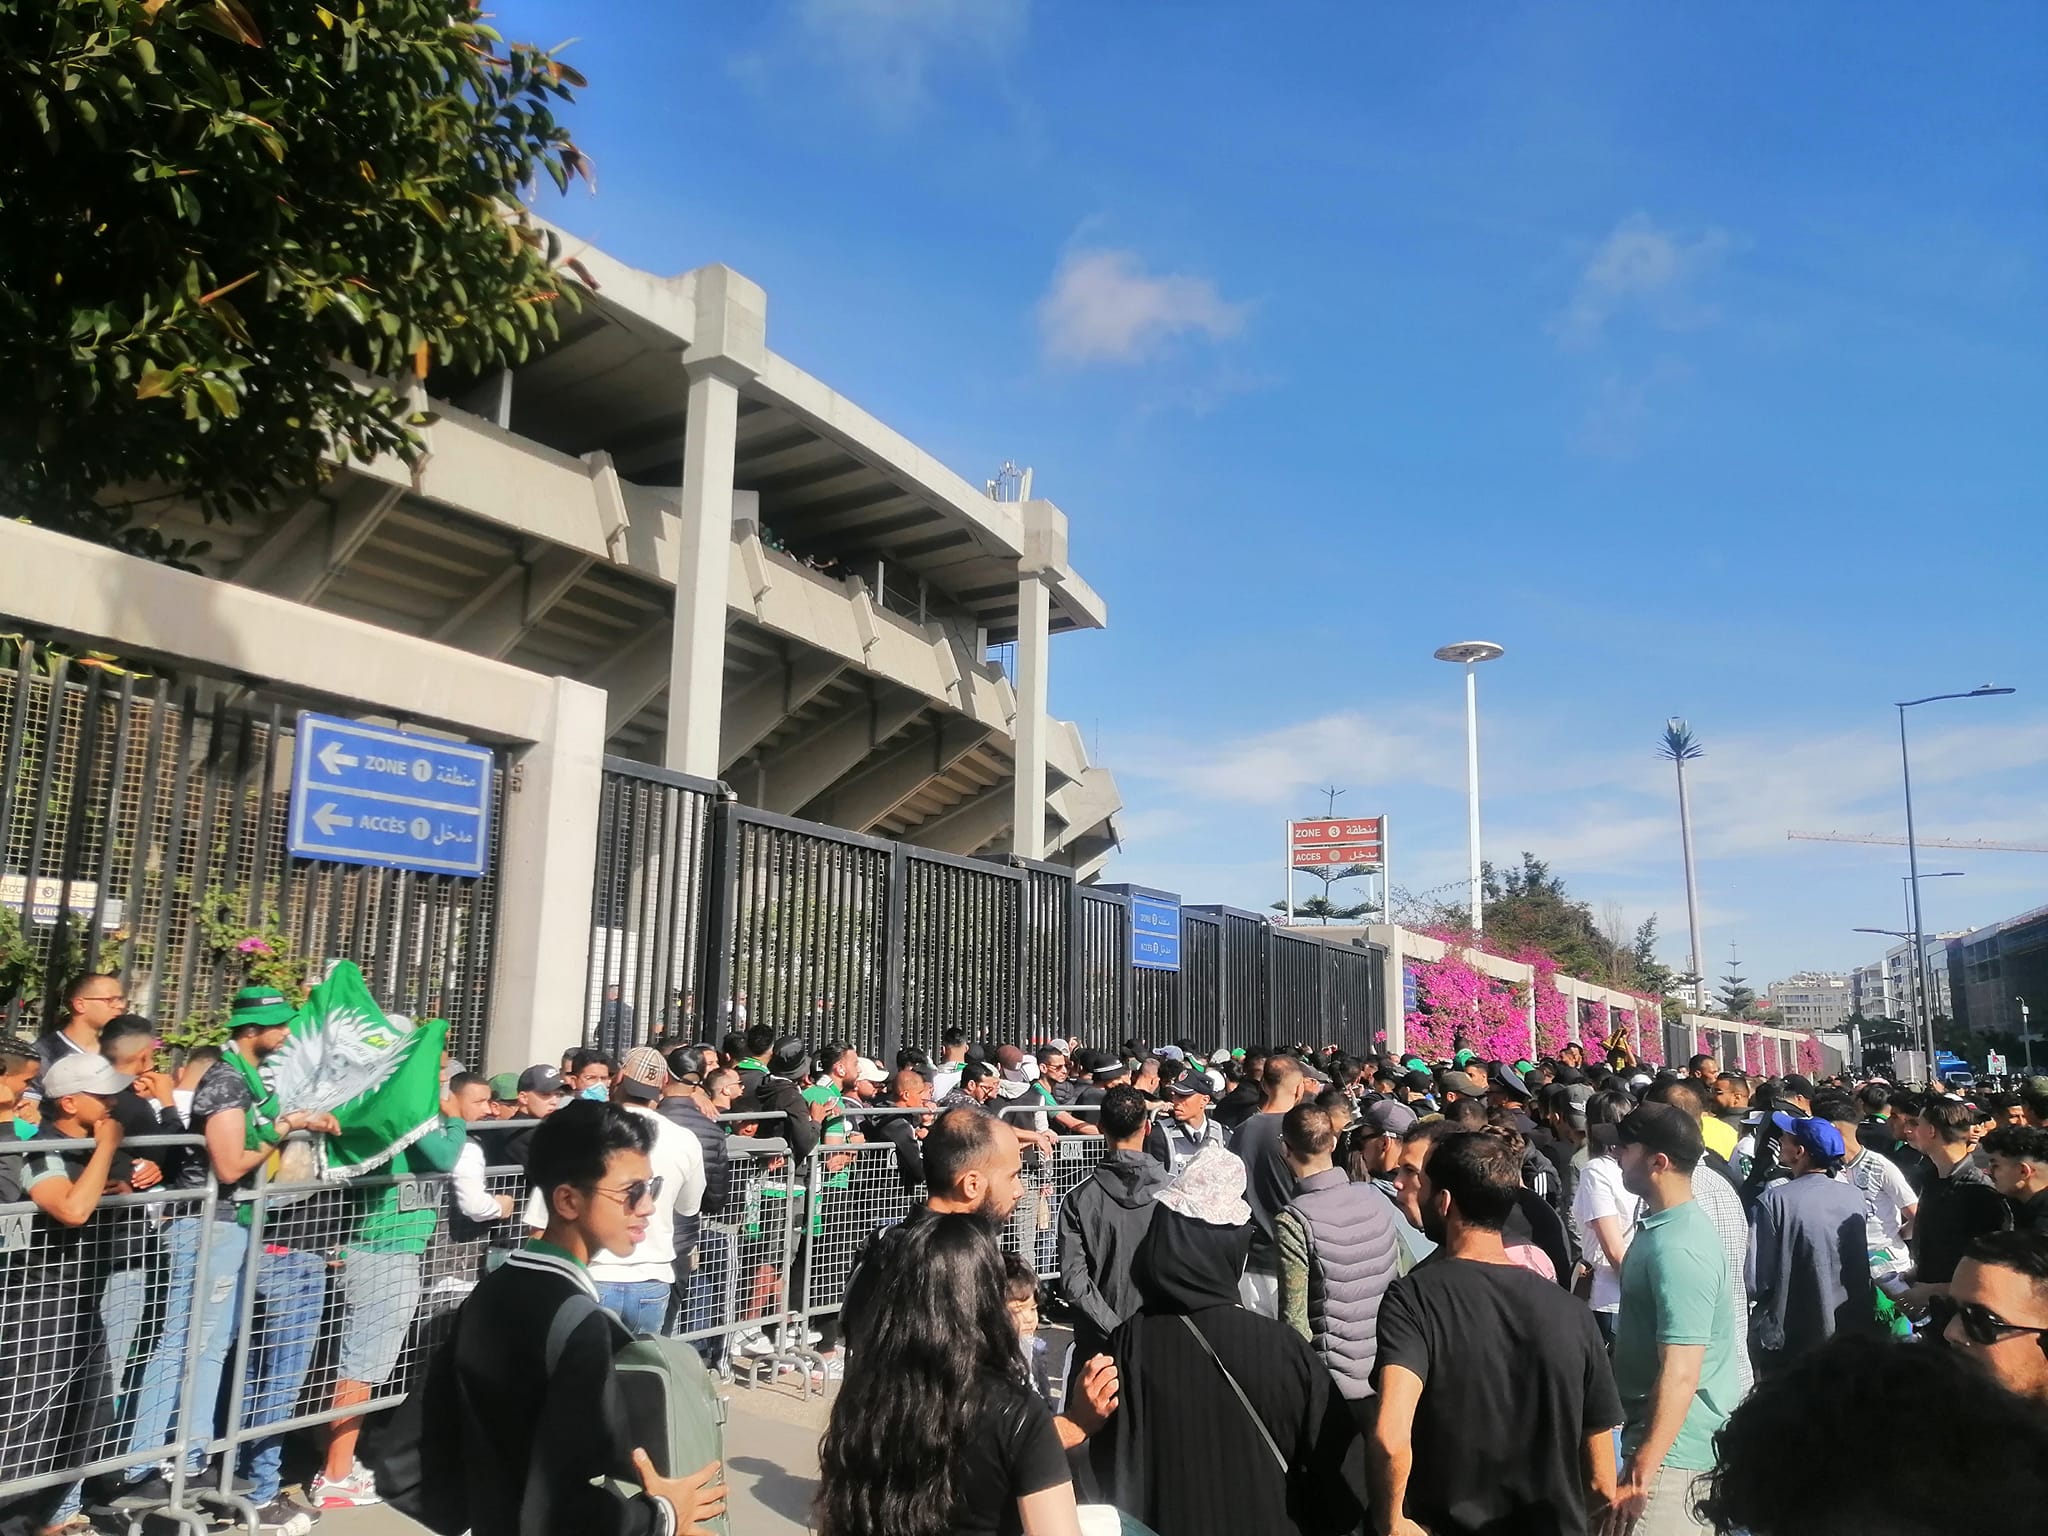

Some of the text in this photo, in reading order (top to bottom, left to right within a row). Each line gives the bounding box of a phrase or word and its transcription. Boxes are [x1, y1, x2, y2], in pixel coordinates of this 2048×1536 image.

[364, 755, 407, 776] ZONE
[436, 765, 476, 787] منطقة
[433, 822, 473, 846] مدخل
[1295, 828, 1321, 838] ZONE
[1349, 850, 1379, 861] مدخل
